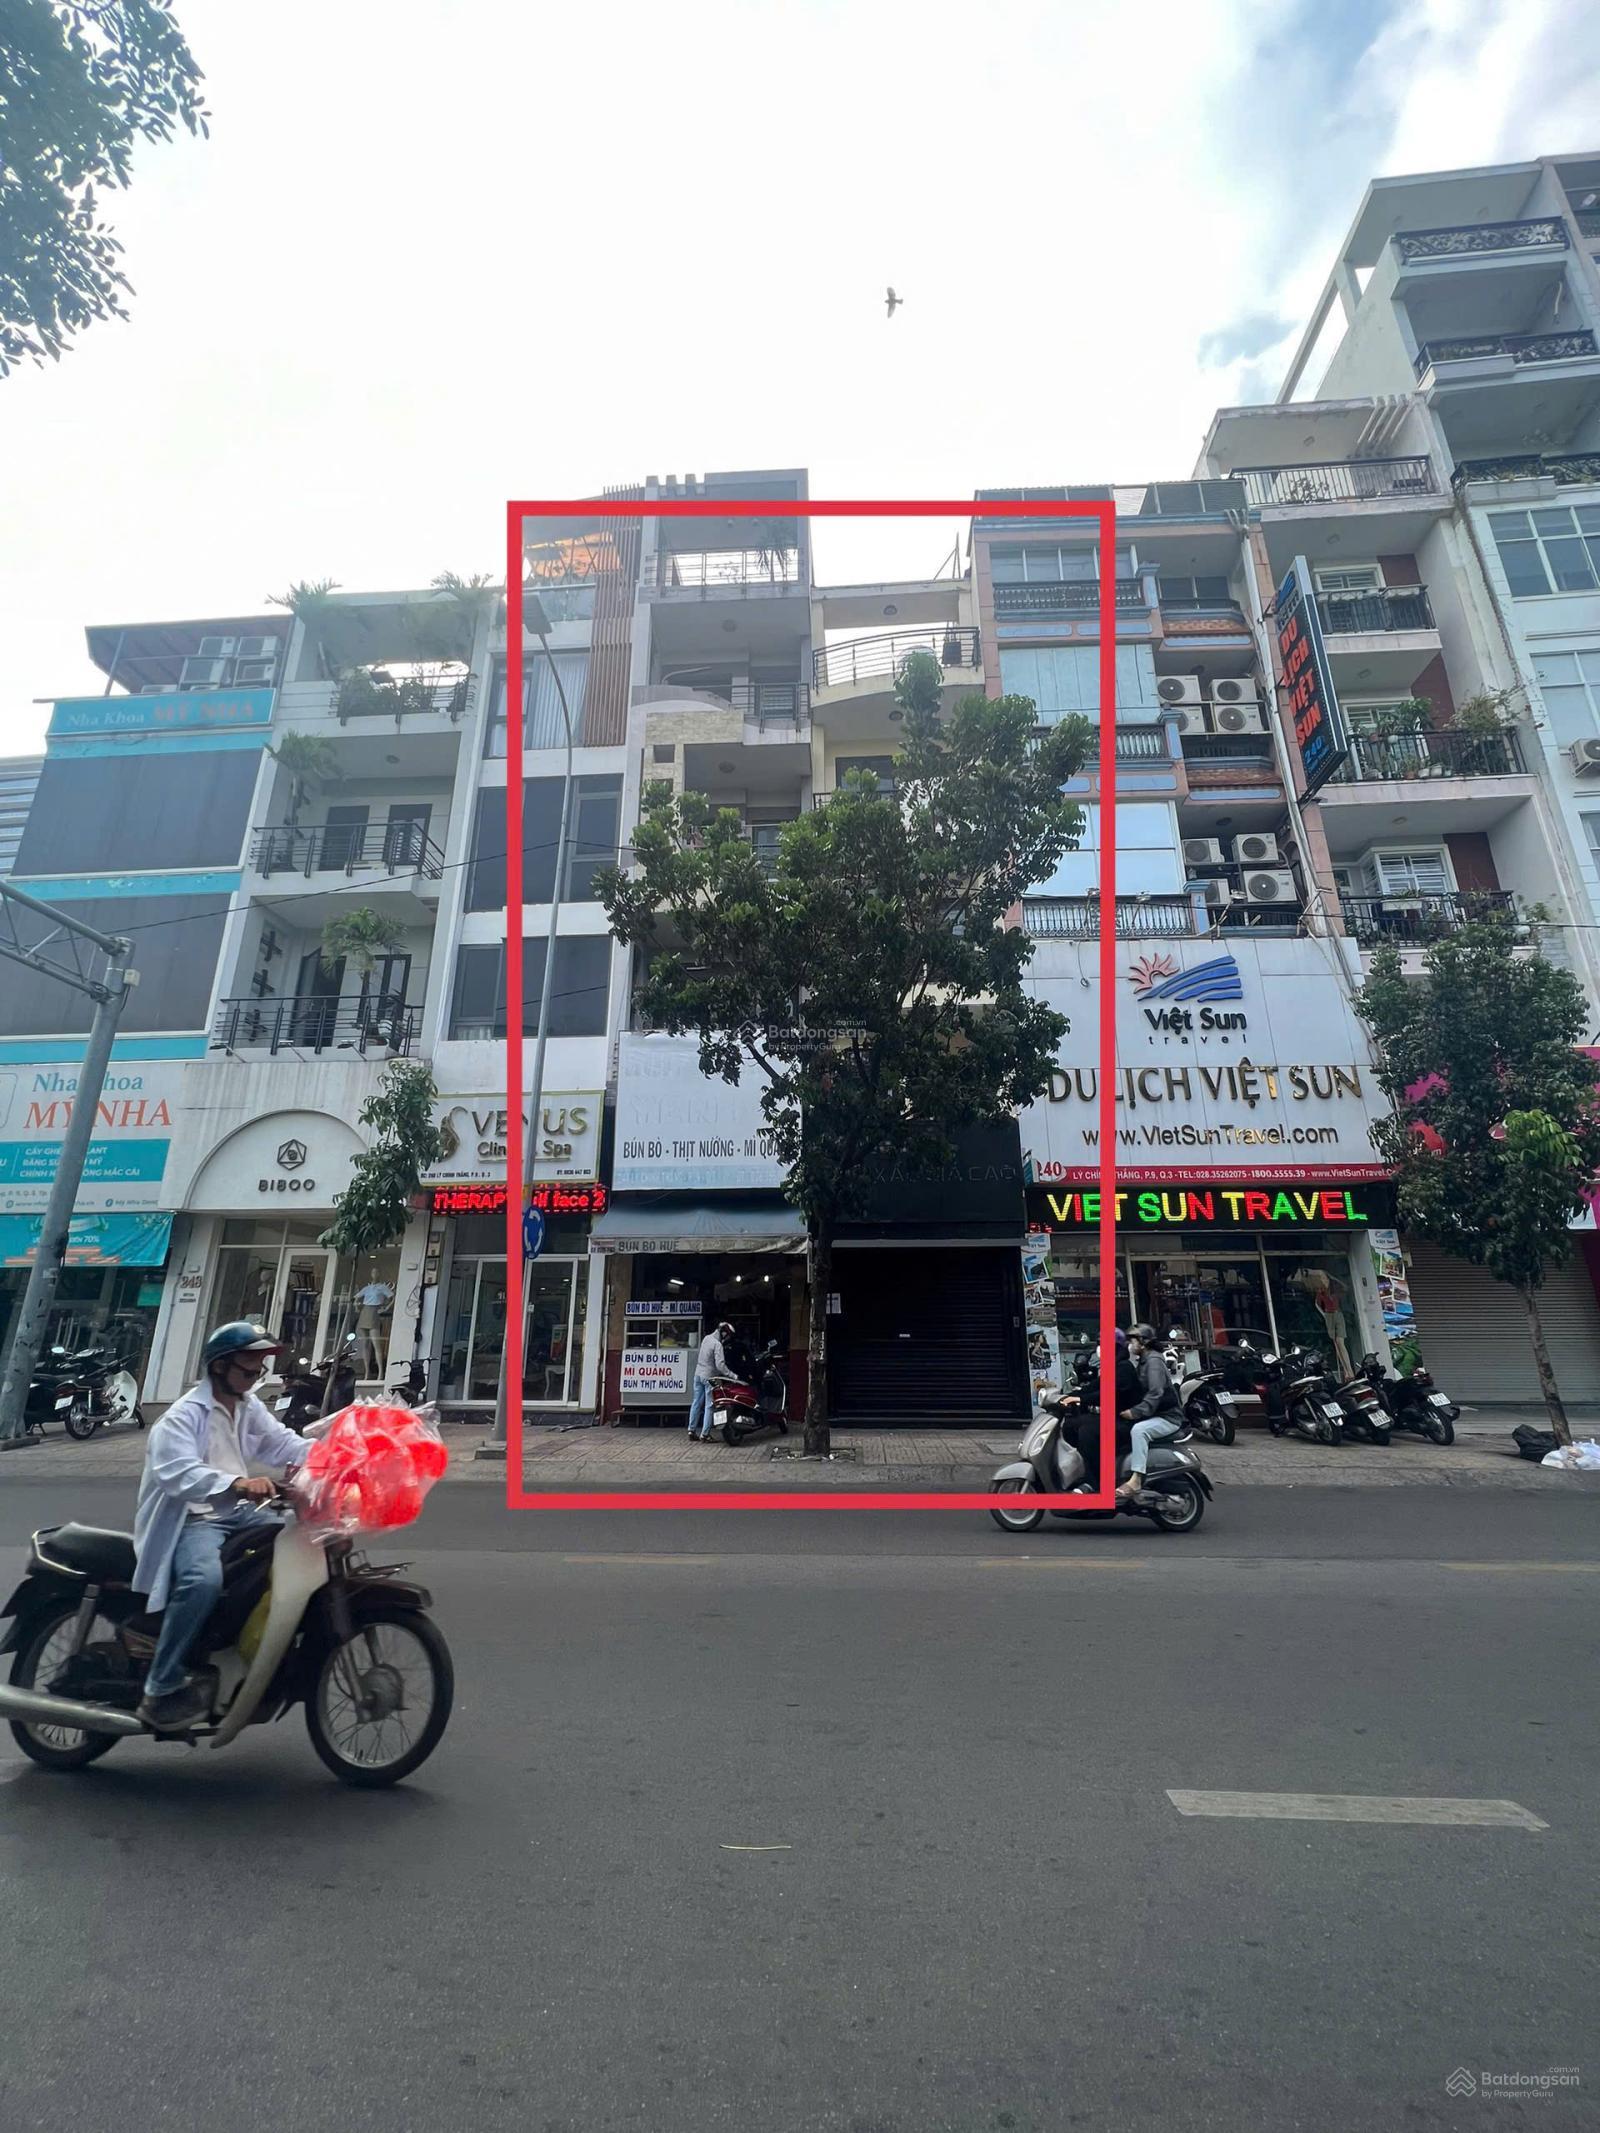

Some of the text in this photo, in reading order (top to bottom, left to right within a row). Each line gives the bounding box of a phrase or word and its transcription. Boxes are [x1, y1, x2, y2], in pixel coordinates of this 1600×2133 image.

[1200, 1007, 1248, 1030] Sun
[1148, 1034, 1247, 1045] travel
[32, 1071, 144, 1092] Nha hoa
[1048, 1067, 1097, 1102] DU
[1198, 1056, 1279, 1109] VIỆT
[1289, 1065, 1363, 1100] SUN
[93, 1098, 173, 1128] NHA
[471, 1107, 588, 1137] VEUS
[542, 1140, 573, 1157] Spa
[623, 1136, 645, 1159] BÚN
[647, 1136, 662, 1159] BÒ
[672, 1140, 696, 1162] THỊT
[699, 1135, 734, 1158] NƯỚNG
[258, 1178, 316, 1193] BIBOO
[434, 1192, 508, 1209] THERAP
[553, 1190, 590, 1207] face
[1046, 1191, 1369, 1222] VIET SUN TRAVEL
[625, 1352, 644, 1363] BÚN
[641, 1379, 657, 1390] THỊT
